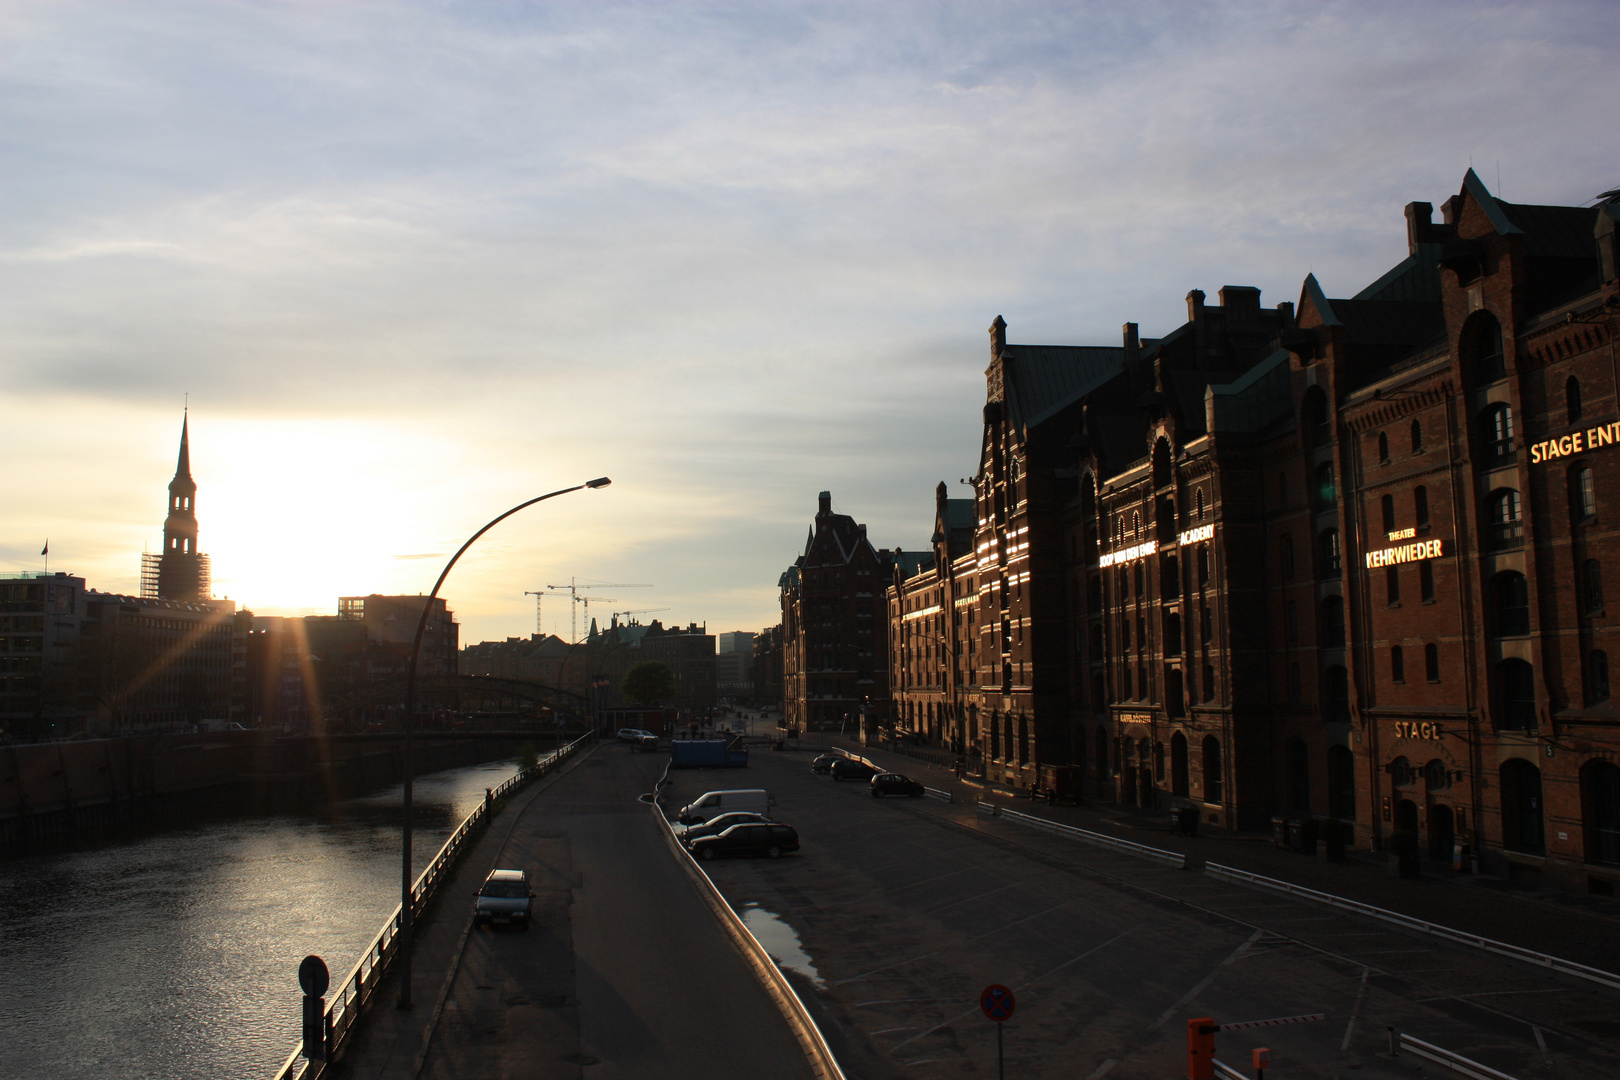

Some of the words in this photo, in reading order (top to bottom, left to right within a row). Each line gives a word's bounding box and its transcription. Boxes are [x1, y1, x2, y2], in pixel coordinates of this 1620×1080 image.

[1531, 432, 1583, 464] STAGE
[1587, 421, 1620, 449] ENT
[1180, 523, 1214, 546] ACADEMY
[1388, 528, 1416, 541] THEATER
[1366, 539, 1443, 569] KEHRWIEDER
